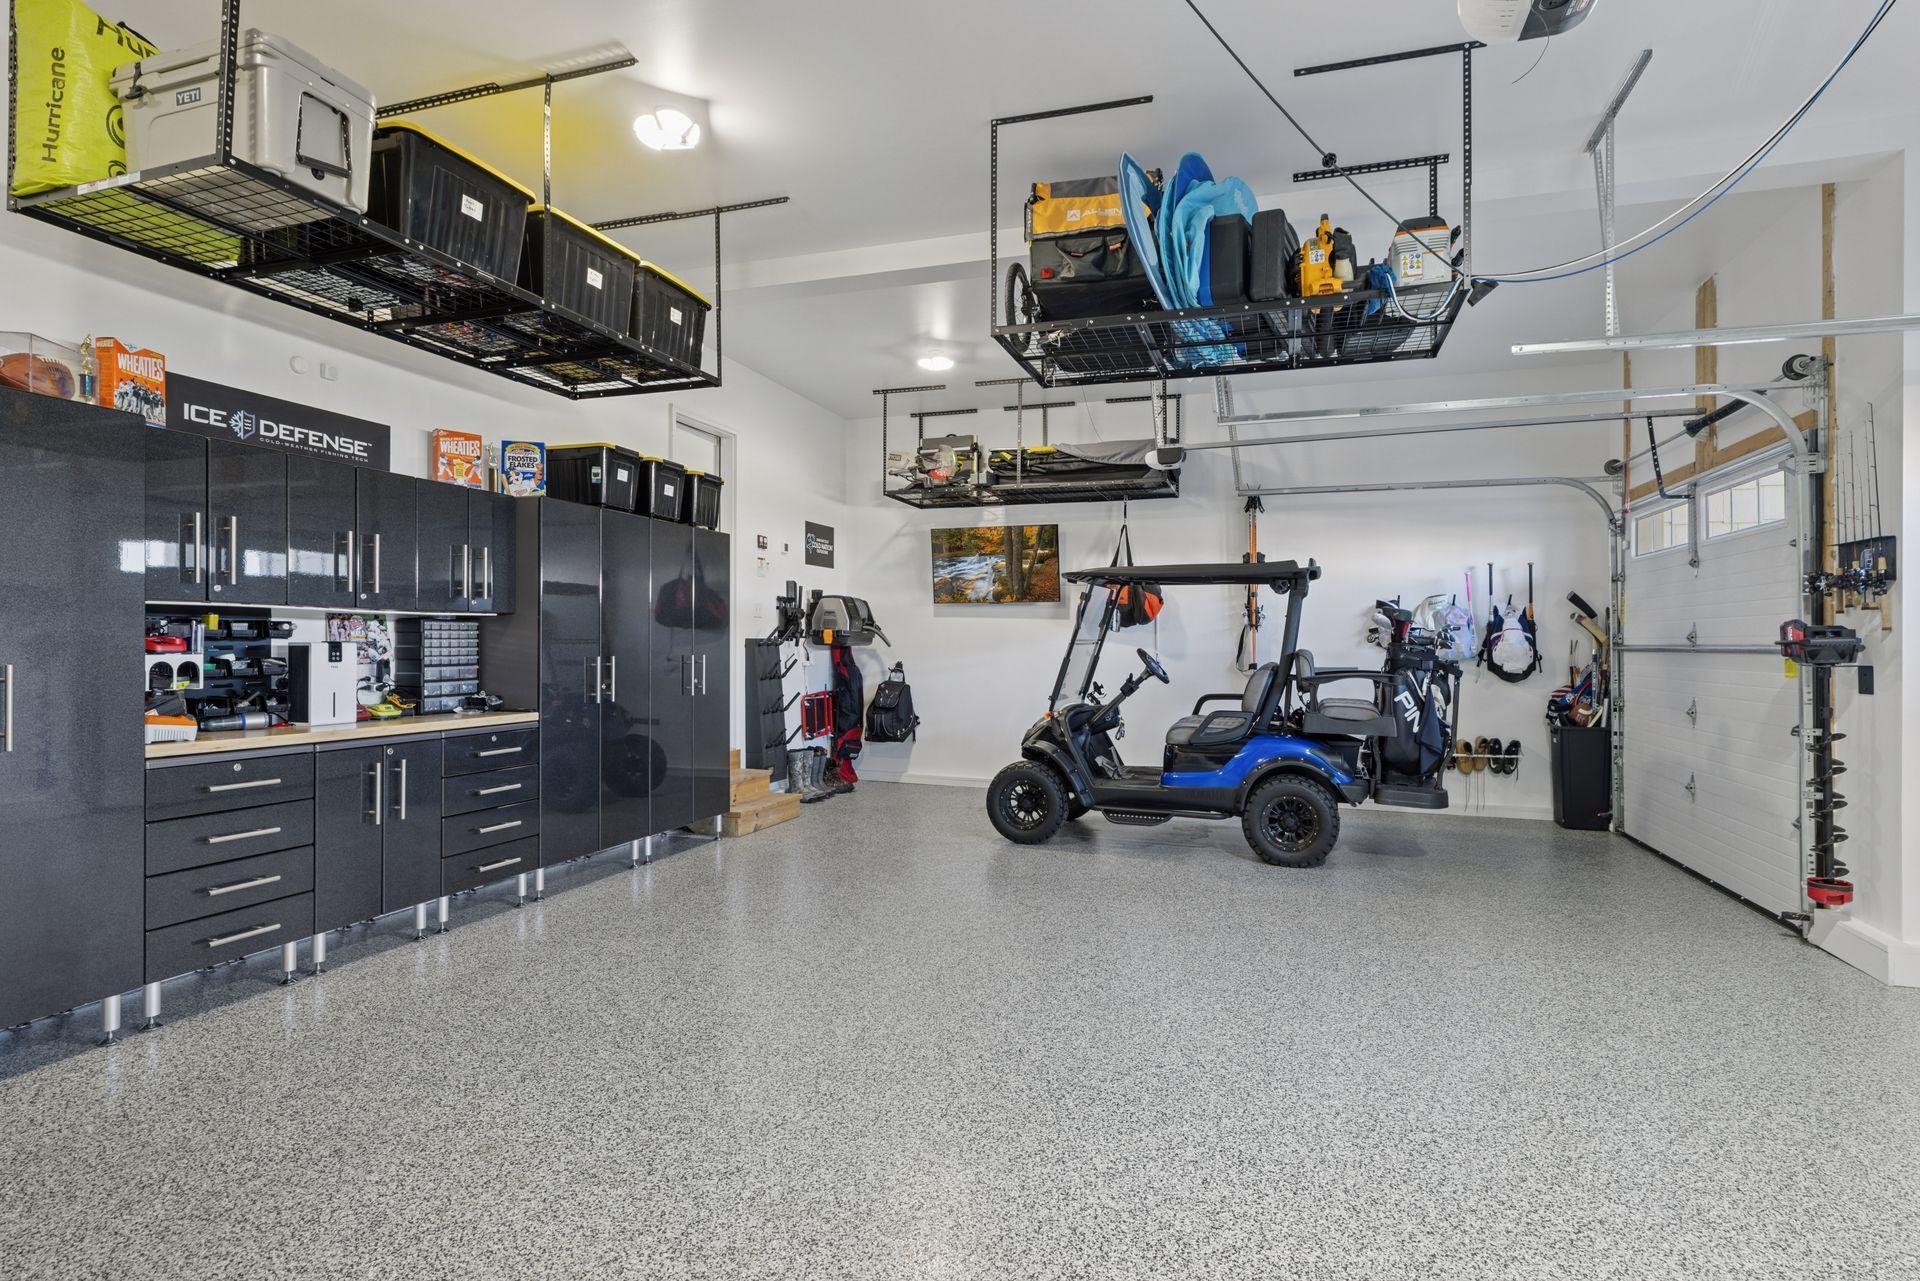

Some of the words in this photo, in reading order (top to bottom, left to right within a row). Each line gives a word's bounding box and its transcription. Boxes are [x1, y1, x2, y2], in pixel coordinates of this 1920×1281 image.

[41, 47, 66, 162] Hurricane
[177, 89, 200, 104] YETI
[117, 352, 164, 382] WHEATIES
[183, 402, 228, 428] ICE
[259, 419, 368, 457] DEFENSE
[320, 450, 349, 459] FISHING
[351, 455, 369, 463] TECH
[440, 440, 481, 457] WHEATIES
[507, 455, 538, 463] FROSTED
[509, 461, 535, 469] FLAKES
